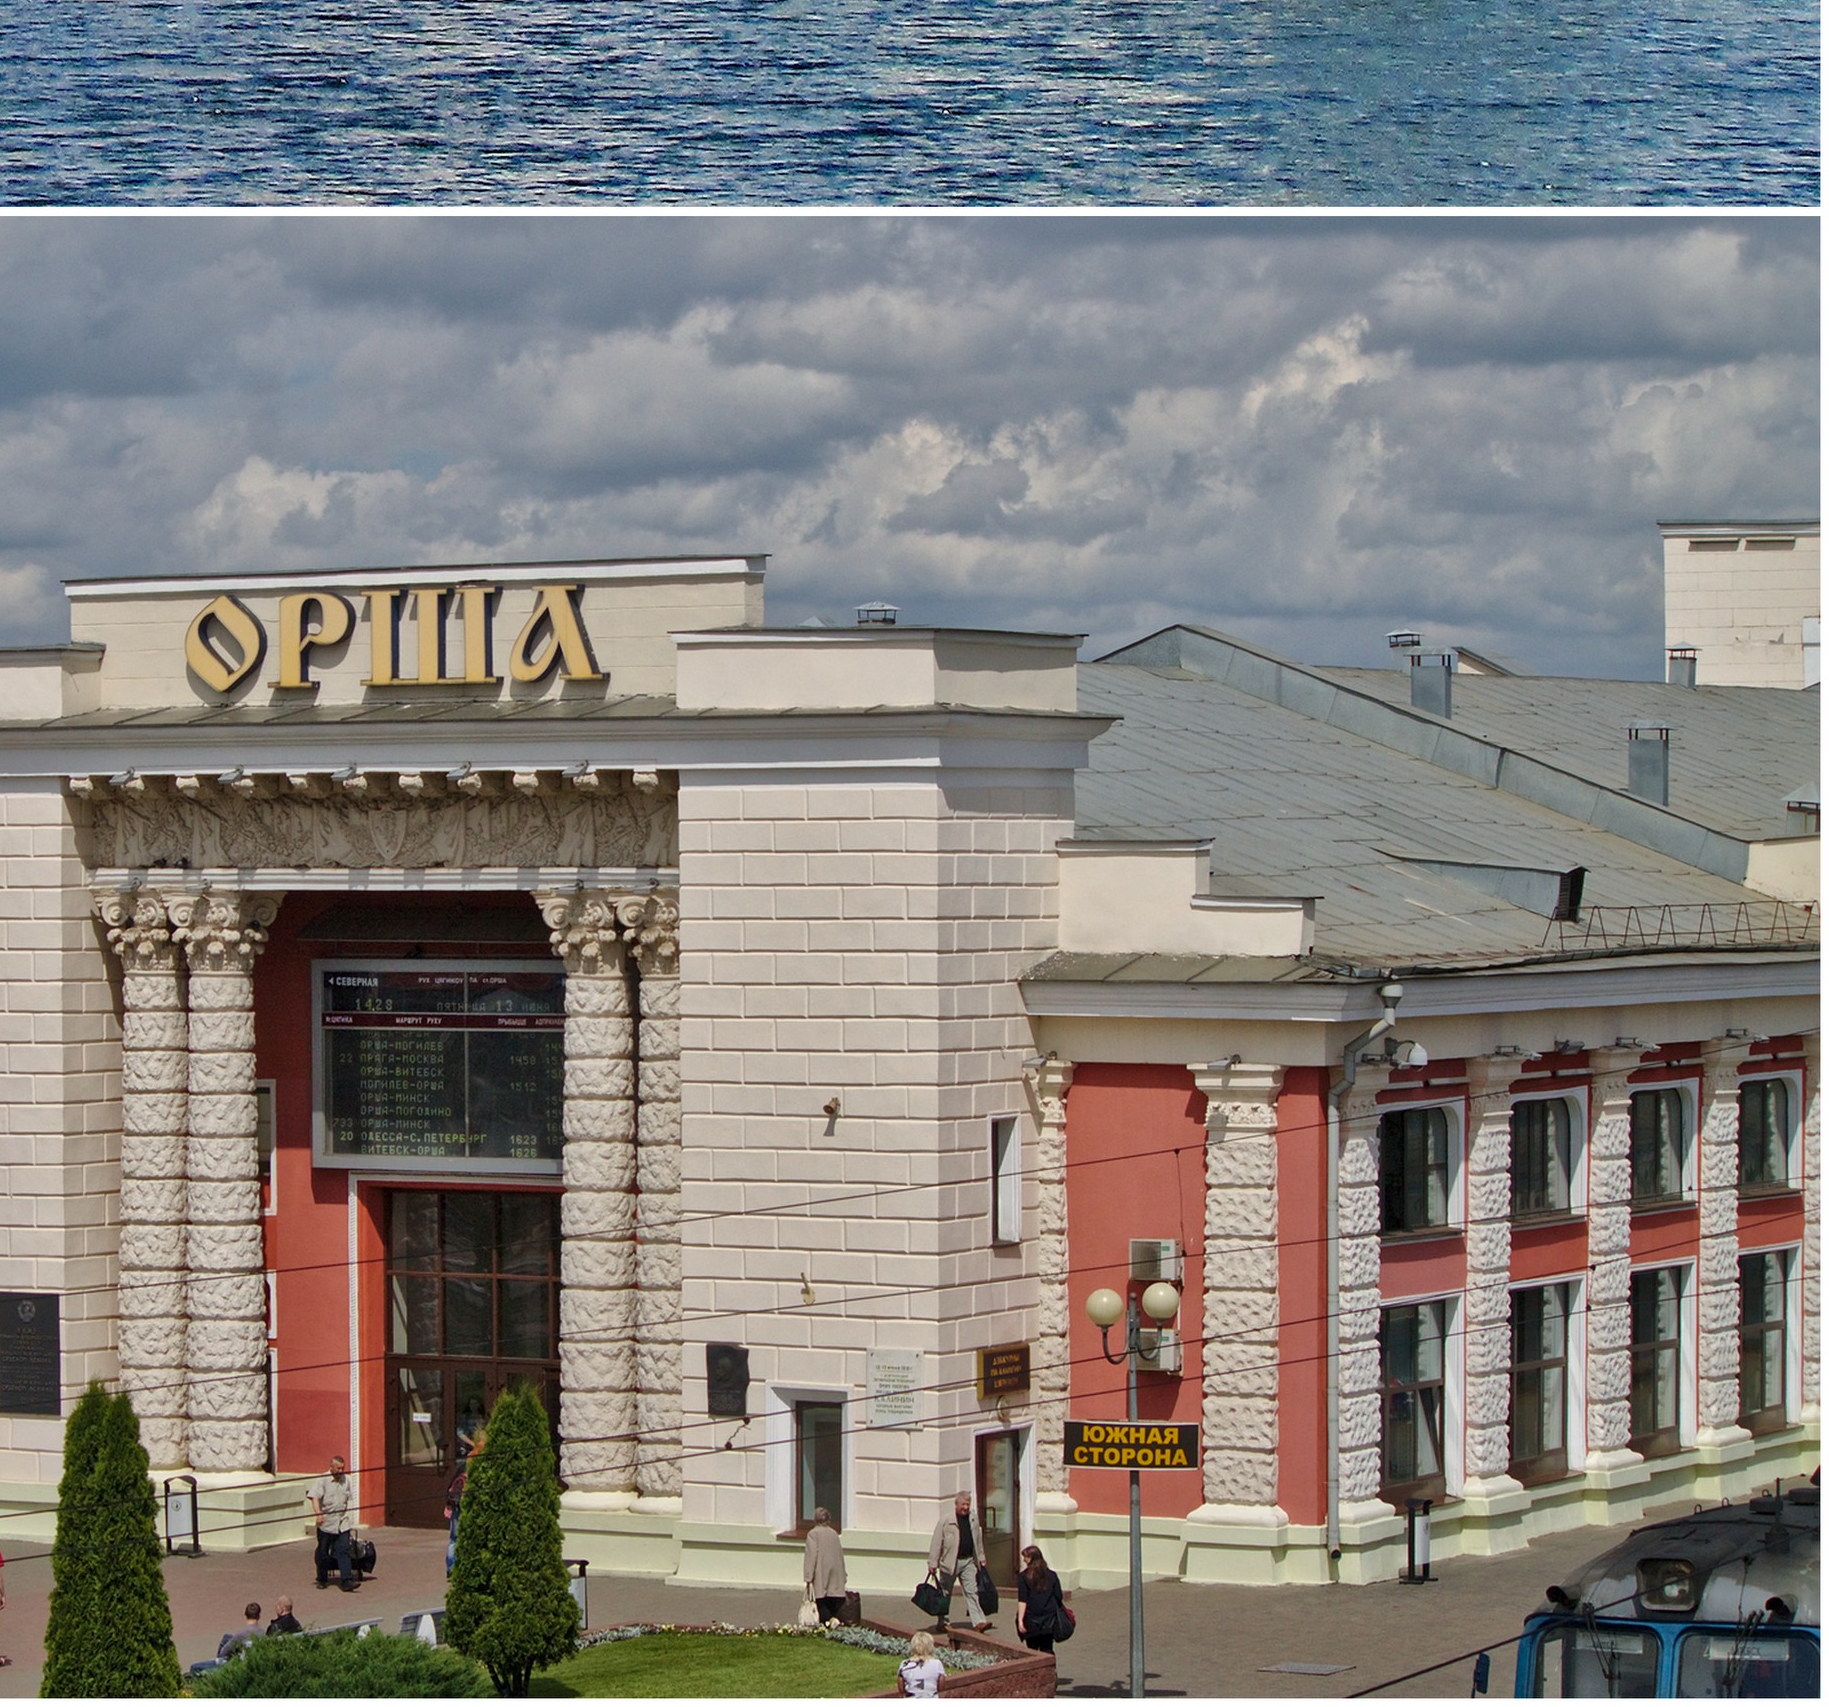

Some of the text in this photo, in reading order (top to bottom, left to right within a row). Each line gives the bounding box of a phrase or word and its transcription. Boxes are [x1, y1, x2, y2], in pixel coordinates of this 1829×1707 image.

[184, 583, 611, 693] ОРША
[336, 976, 379, 987] СЕВЕРНАЯ
[496, 999, 513, 1012] 13
[360, 1040, 444, 1051] ОРША-МОГИЛЕВ
[339, 1053, 353, 1063] 22
[360, 1053, 444, 1064] ПРАГА-МОСКВА
[509, 1055, 537, 1066] 1458
[360, 1066, 444, 1077] ОРША-ВИТЕБСК
[360, 1079, 444, 1091] МОГИЛЕВ-ОРША
[360, 1092, 431, 1103] ОРША-МИНСК
[360, 1105, 452, 1117] ОРША-ПОГОДИНО
[360, 1119, 431, 1130] ОРША-МИНСК
[339, 1131, 354, 1141] 20
[510, 1134, 537, 1145] 1623
[360, 1144, 538, 1158] ВИТЕБСК-ОРША 1626
[1082, 1425, 1179, 1445] ЮЖНАЯ
[1073, 1445, 1188, 1466] СТОРОНА
